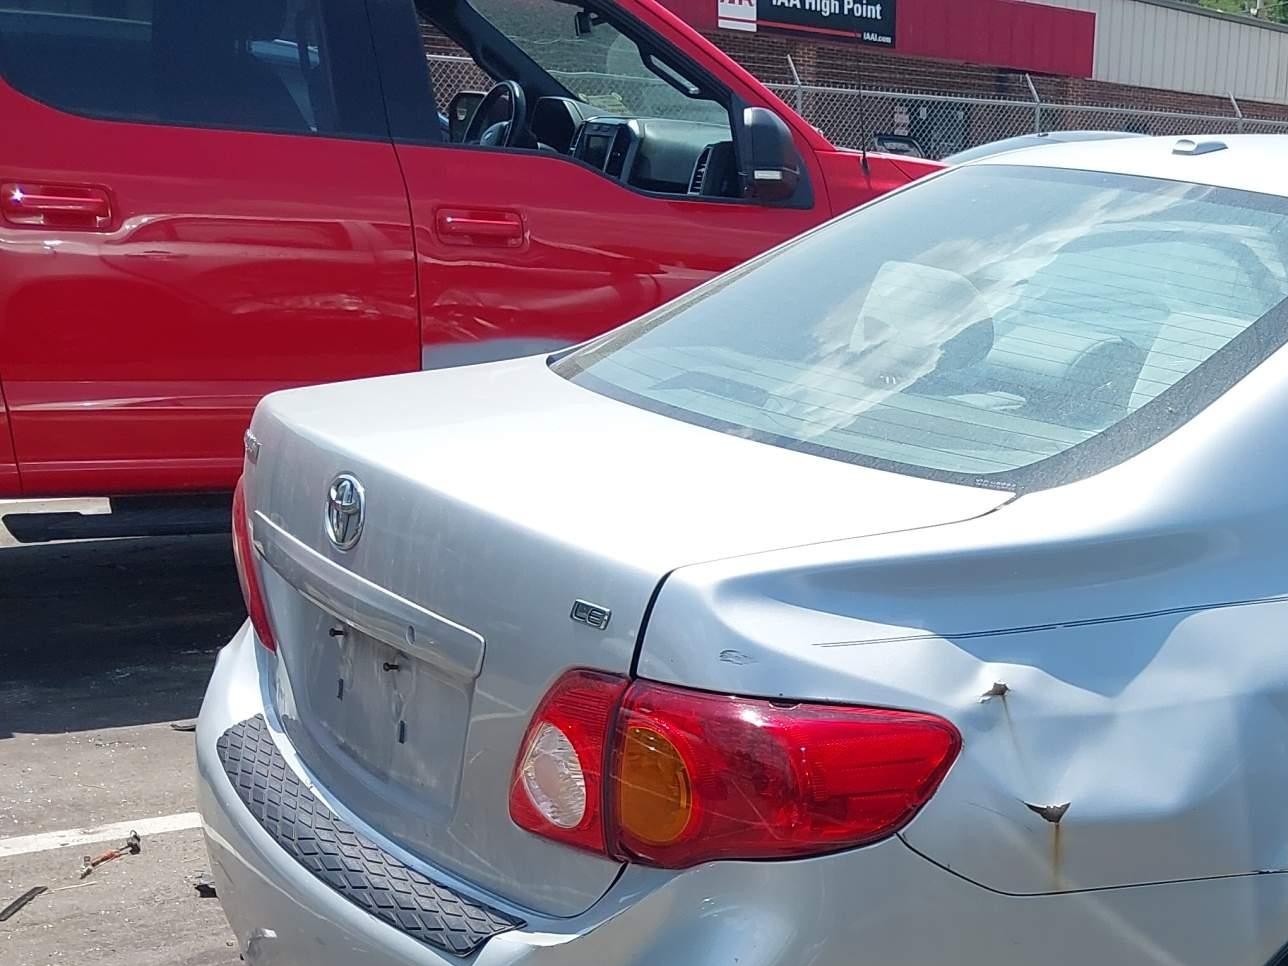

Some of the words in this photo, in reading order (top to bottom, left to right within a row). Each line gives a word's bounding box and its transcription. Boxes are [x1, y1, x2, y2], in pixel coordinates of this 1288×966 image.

[804, 0, 839, 16] High
[843, 0, 882, 19] Point
[572, 601, 608, 628] LE
